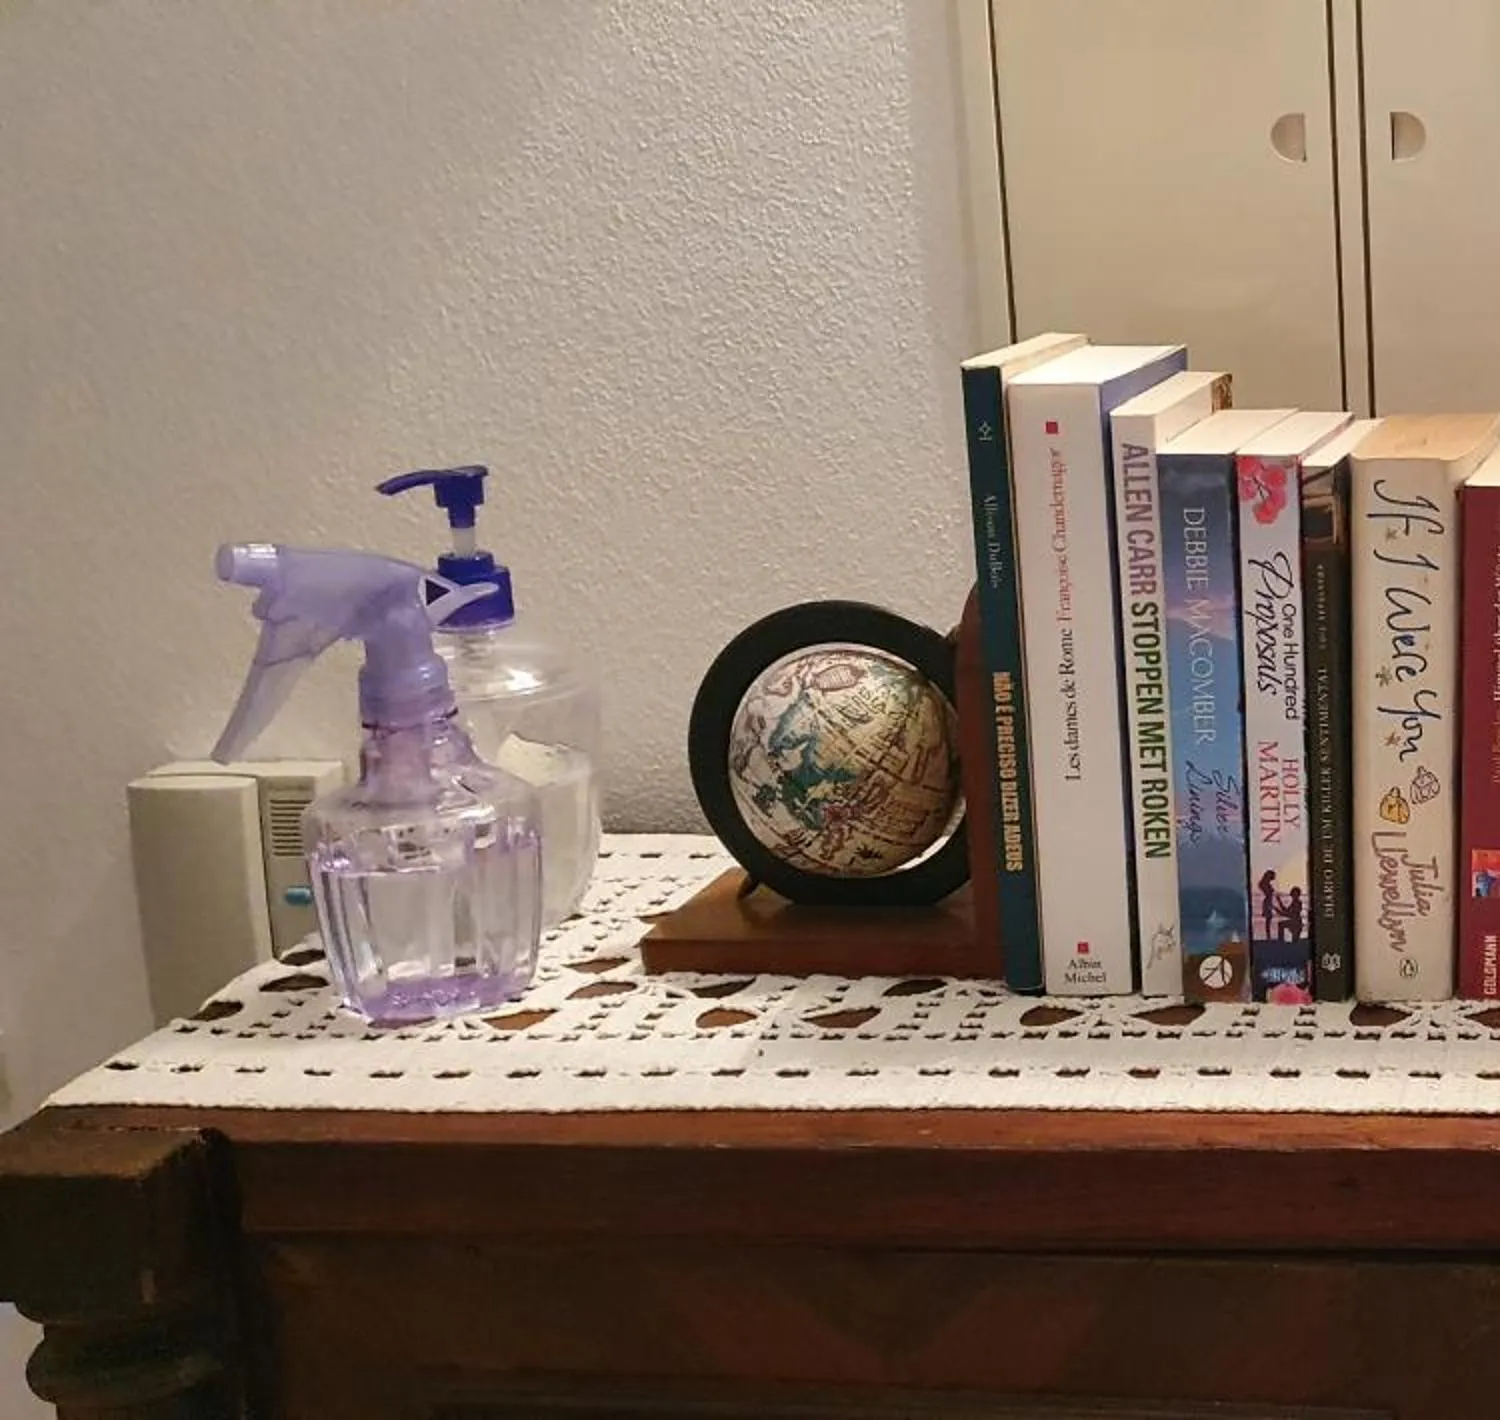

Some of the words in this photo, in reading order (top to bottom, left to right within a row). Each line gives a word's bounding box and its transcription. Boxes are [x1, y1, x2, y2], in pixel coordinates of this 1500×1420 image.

[1121, 443, 1152, 525] ALLEN
[1367, 479, 1444, 536] If
[1126, 531, 1156, 596] CARR
[1183, 508, 1209, 589] DEBBIE
[1374, 549, 1440, 570] I
[1058, 629, 1076, 676] Rome
[1245, 551, 1294, 695] Proposals
[1282, 603, 1297, 638] One
[1385, 587, 1431, 682] Were
[1060, 679, 1077, 699] de
[1131, 602, 1164, 720] STOPPEN
[1185, 599, 1216, 745] MACOMBER
[1283, 643, 1299, 721] Hundred
[1062, 701, 1079, 750] dames
[1137, 723, 1167, 772] MET
[1377, 689, 1441, 762] You
[1064, 753, 1081, 781] Les
[1258, 741, 1281, 843] MARTIN
[1282, 758, 1301, 828] HOLLY
[1004, 824, 1023, 871] ADEUS
[1142, 779, 1171, 859] ROKEN
[1401, 849, 1444, 917] Julia
